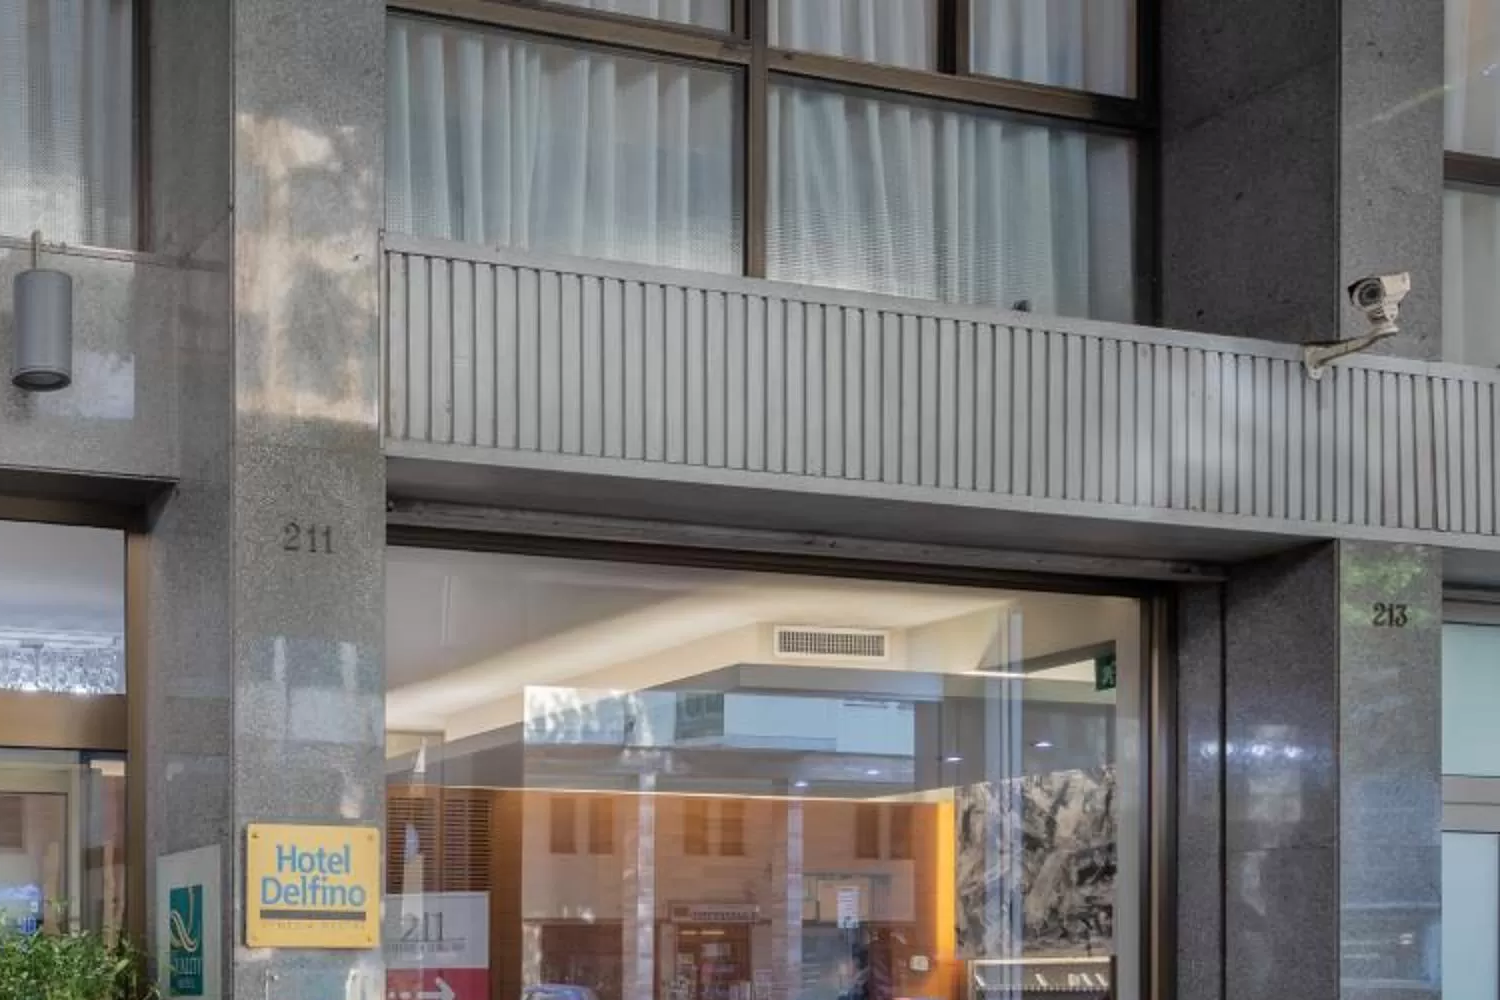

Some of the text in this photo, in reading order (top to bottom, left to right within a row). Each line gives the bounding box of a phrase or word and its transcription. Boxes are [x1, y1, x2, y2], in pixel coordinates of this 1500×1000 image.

[283, 520, 337, 554] 211
[1372, 602, 1408, 628] 213
[276, 843, 350, 874] Hotel
[261, 875, 366, 907] Delfino
